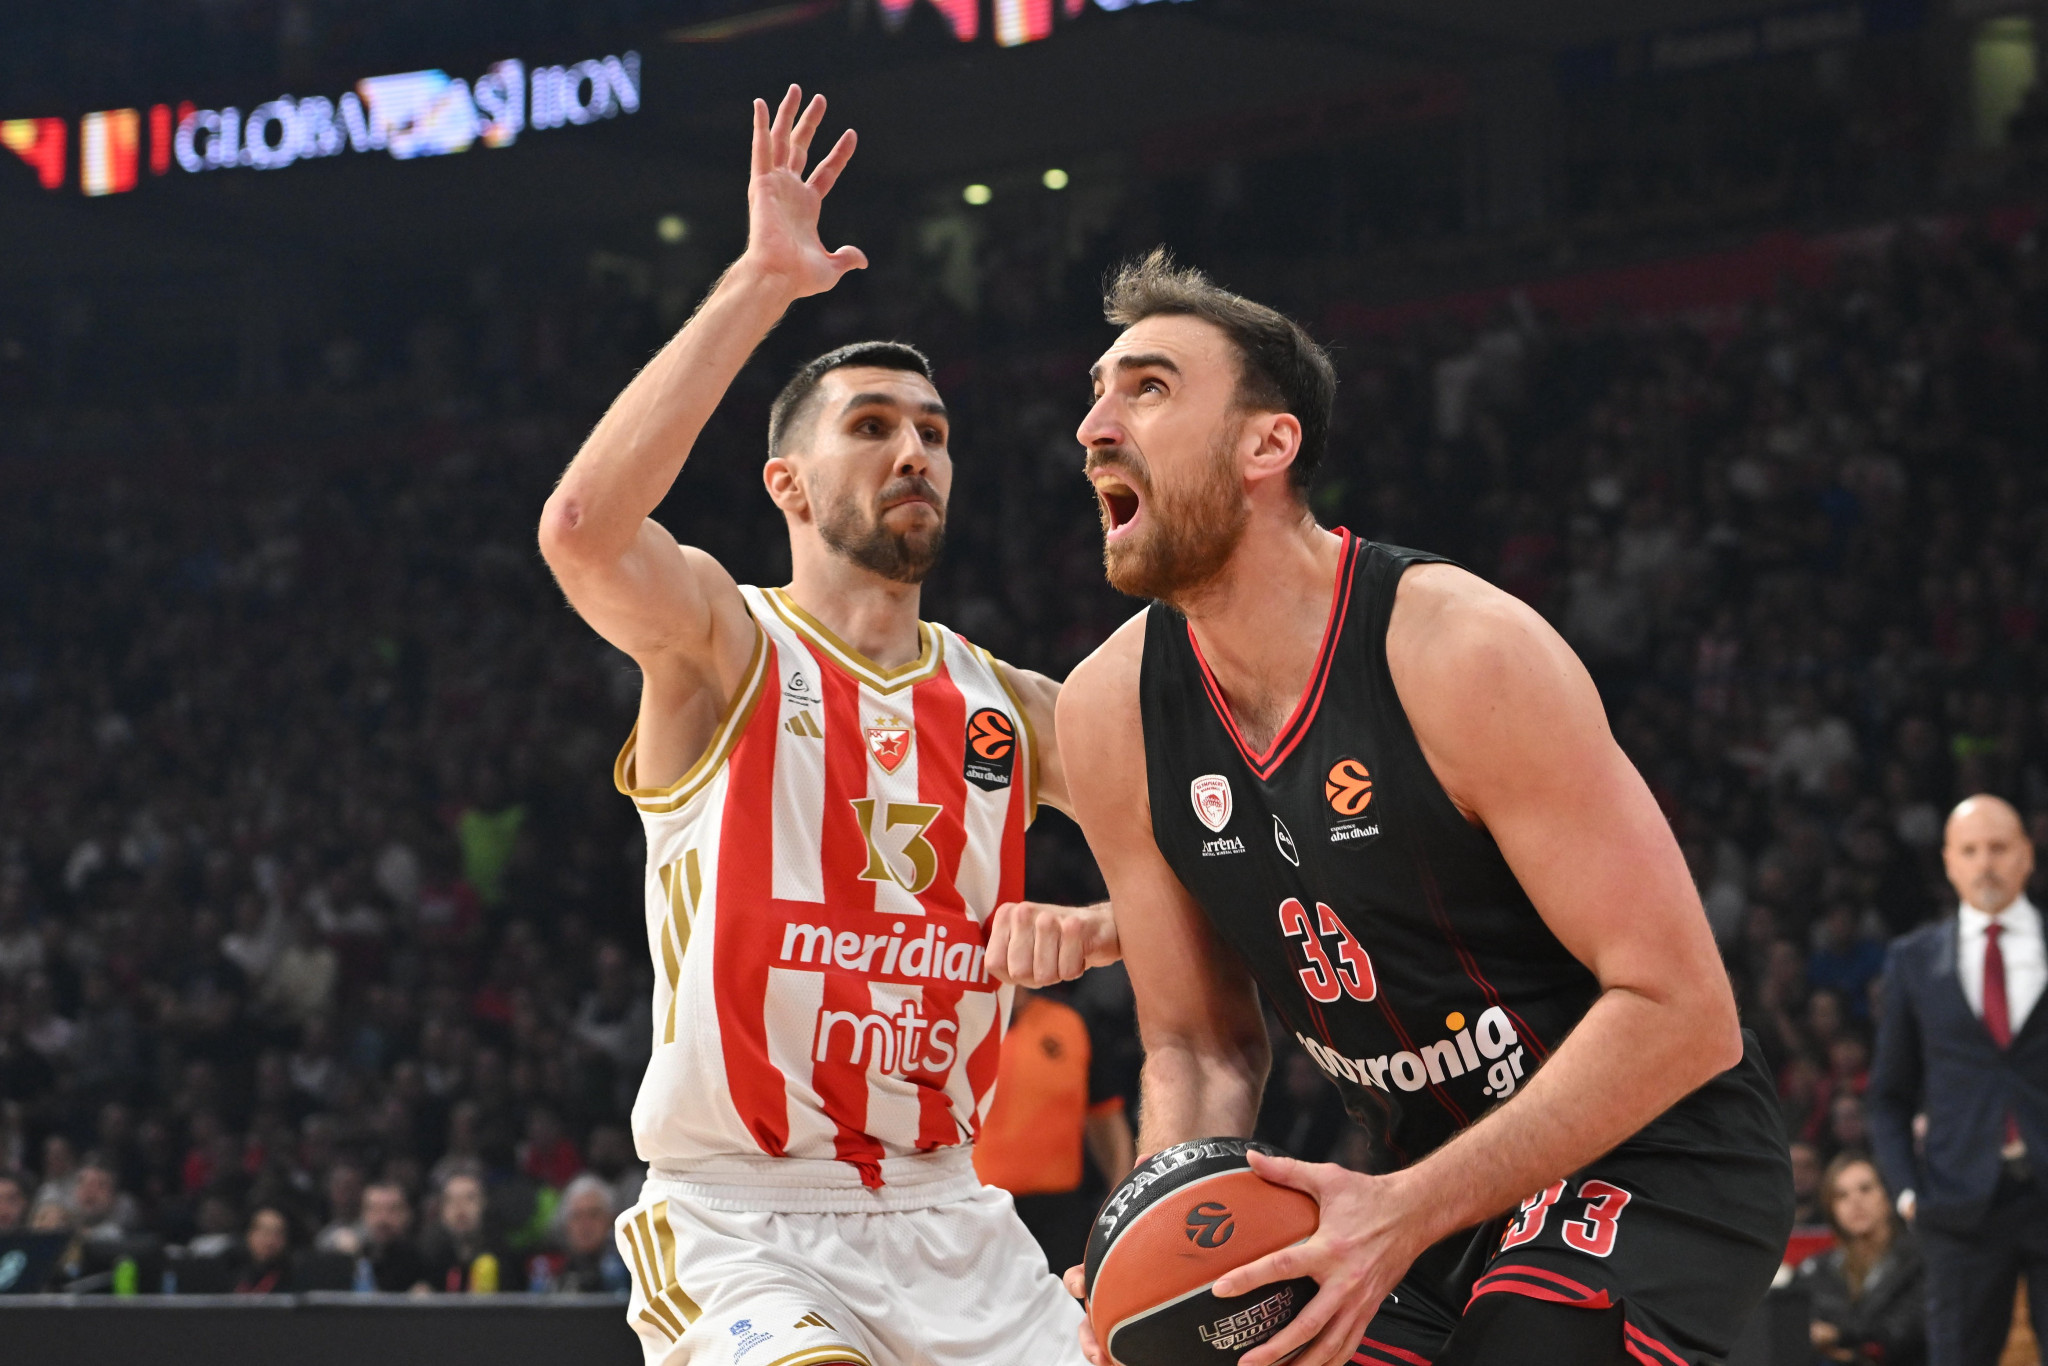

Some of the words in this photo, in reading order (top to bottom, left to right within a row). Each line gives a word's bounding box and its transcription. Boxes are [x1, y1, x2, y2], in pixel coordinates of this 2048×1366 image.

[966, 769, 984, 779] abu
[984, 772, 1009, 784] dhabi
[848, 798, 943, 894] 13
[1330, 823, 1356, 832] experience
[1330, 829, 1350, 842] abu
[1350, 824, 1379, 839] dhabi
[780, 921, 990, 984] meridian
[1279, 897, 1377, 1002] 33
[816, 1003, 957, 1073] mts
[1483, 1044, 1525, 1099] .gr
[1501, 1179, 1632, 1258] 33
[1199, 1286, 1294, 1343] LEGACY
